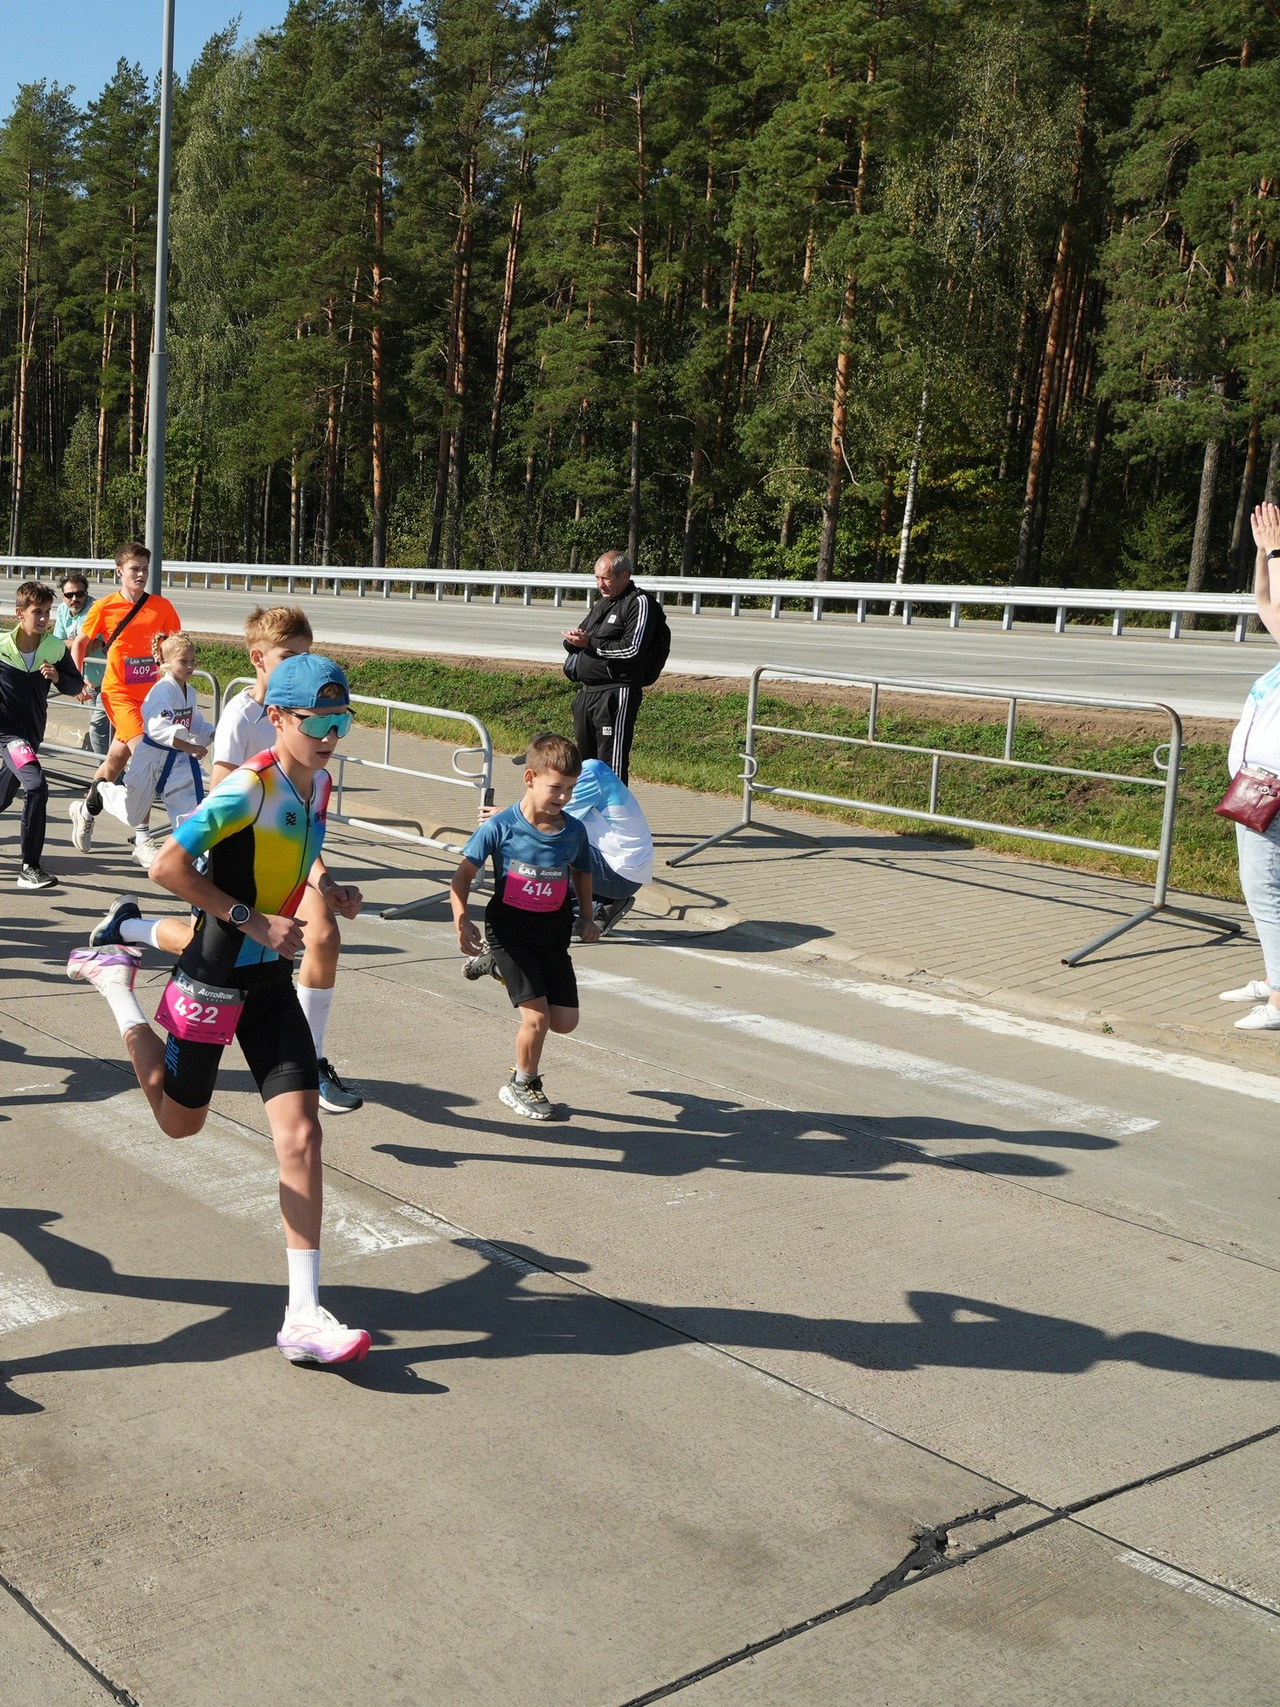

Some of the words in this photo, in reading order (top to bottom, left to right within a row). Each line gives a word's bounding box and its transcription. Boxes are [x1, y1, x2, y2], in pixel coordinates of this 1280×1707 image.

[132, 665, 151, 675] 409
[521, 880, 553, 897] 414
[173, 995, 219, 1024] 422
